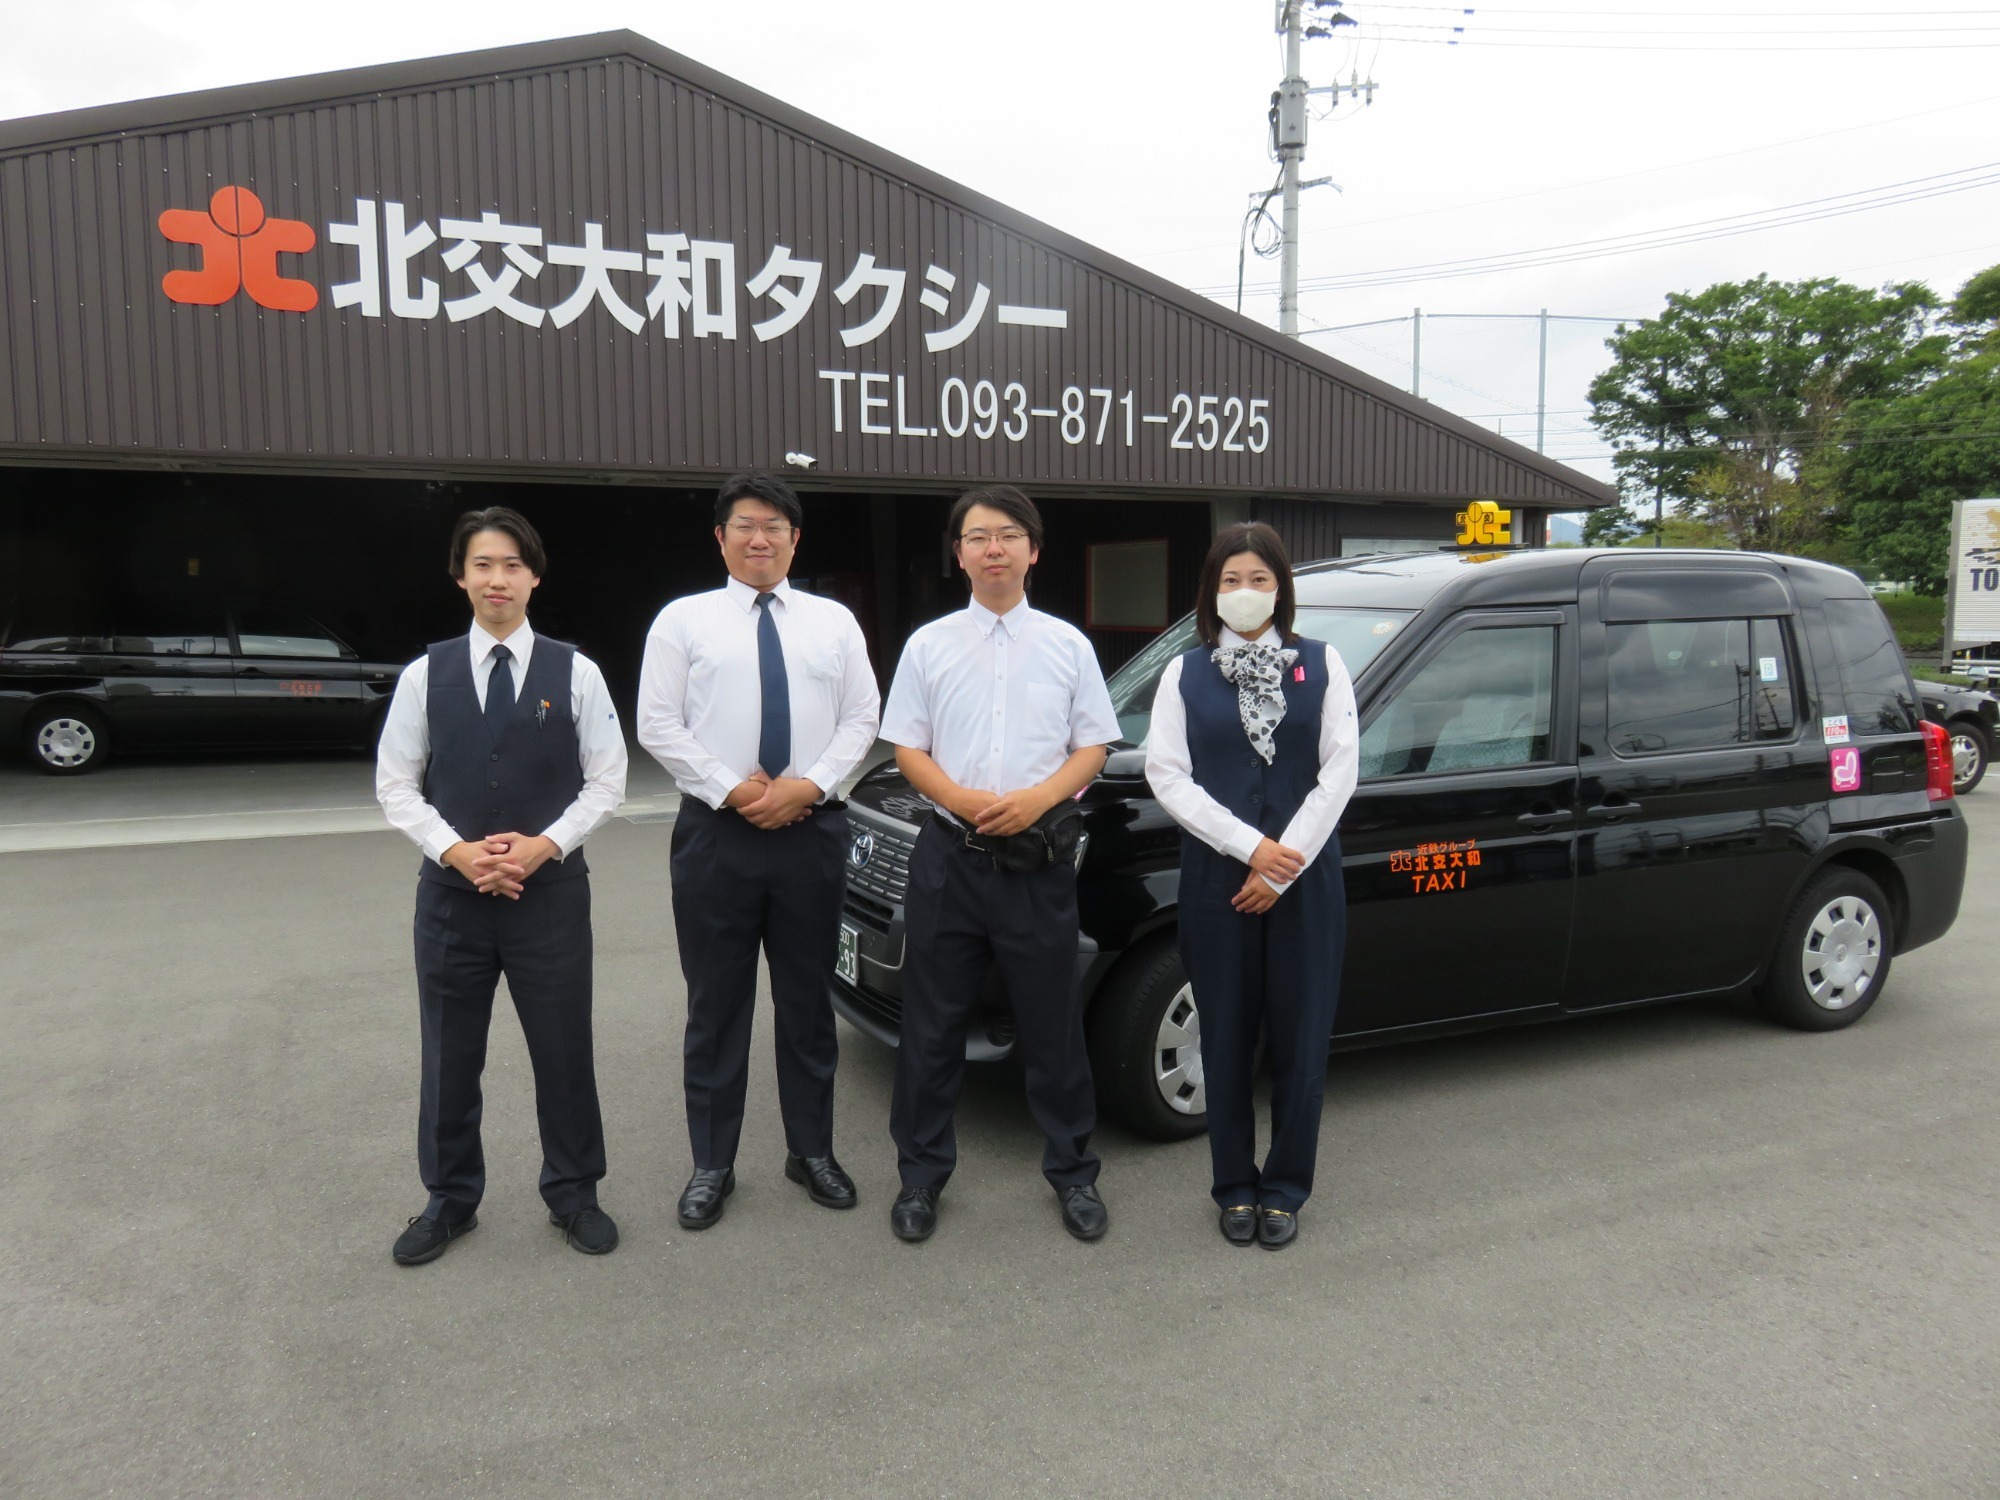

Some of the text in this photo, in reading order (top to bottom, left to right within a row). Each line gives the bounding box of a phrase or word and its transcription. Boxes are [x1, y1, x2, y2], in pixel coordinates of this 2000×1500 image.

[328, 199, 1068, 352] 北交大和タクシー
[819, 369, 1270, 454] TEL.093-871-2525
[1970, 567, 1999, 591] TO
[1417, 838, 1476, 855] 近鉄グループ
[1414, 850, 1481, 871] 北交大和
[1411, 870, 1466, 893] TAXI
[837, 945, 856, 979] -93
